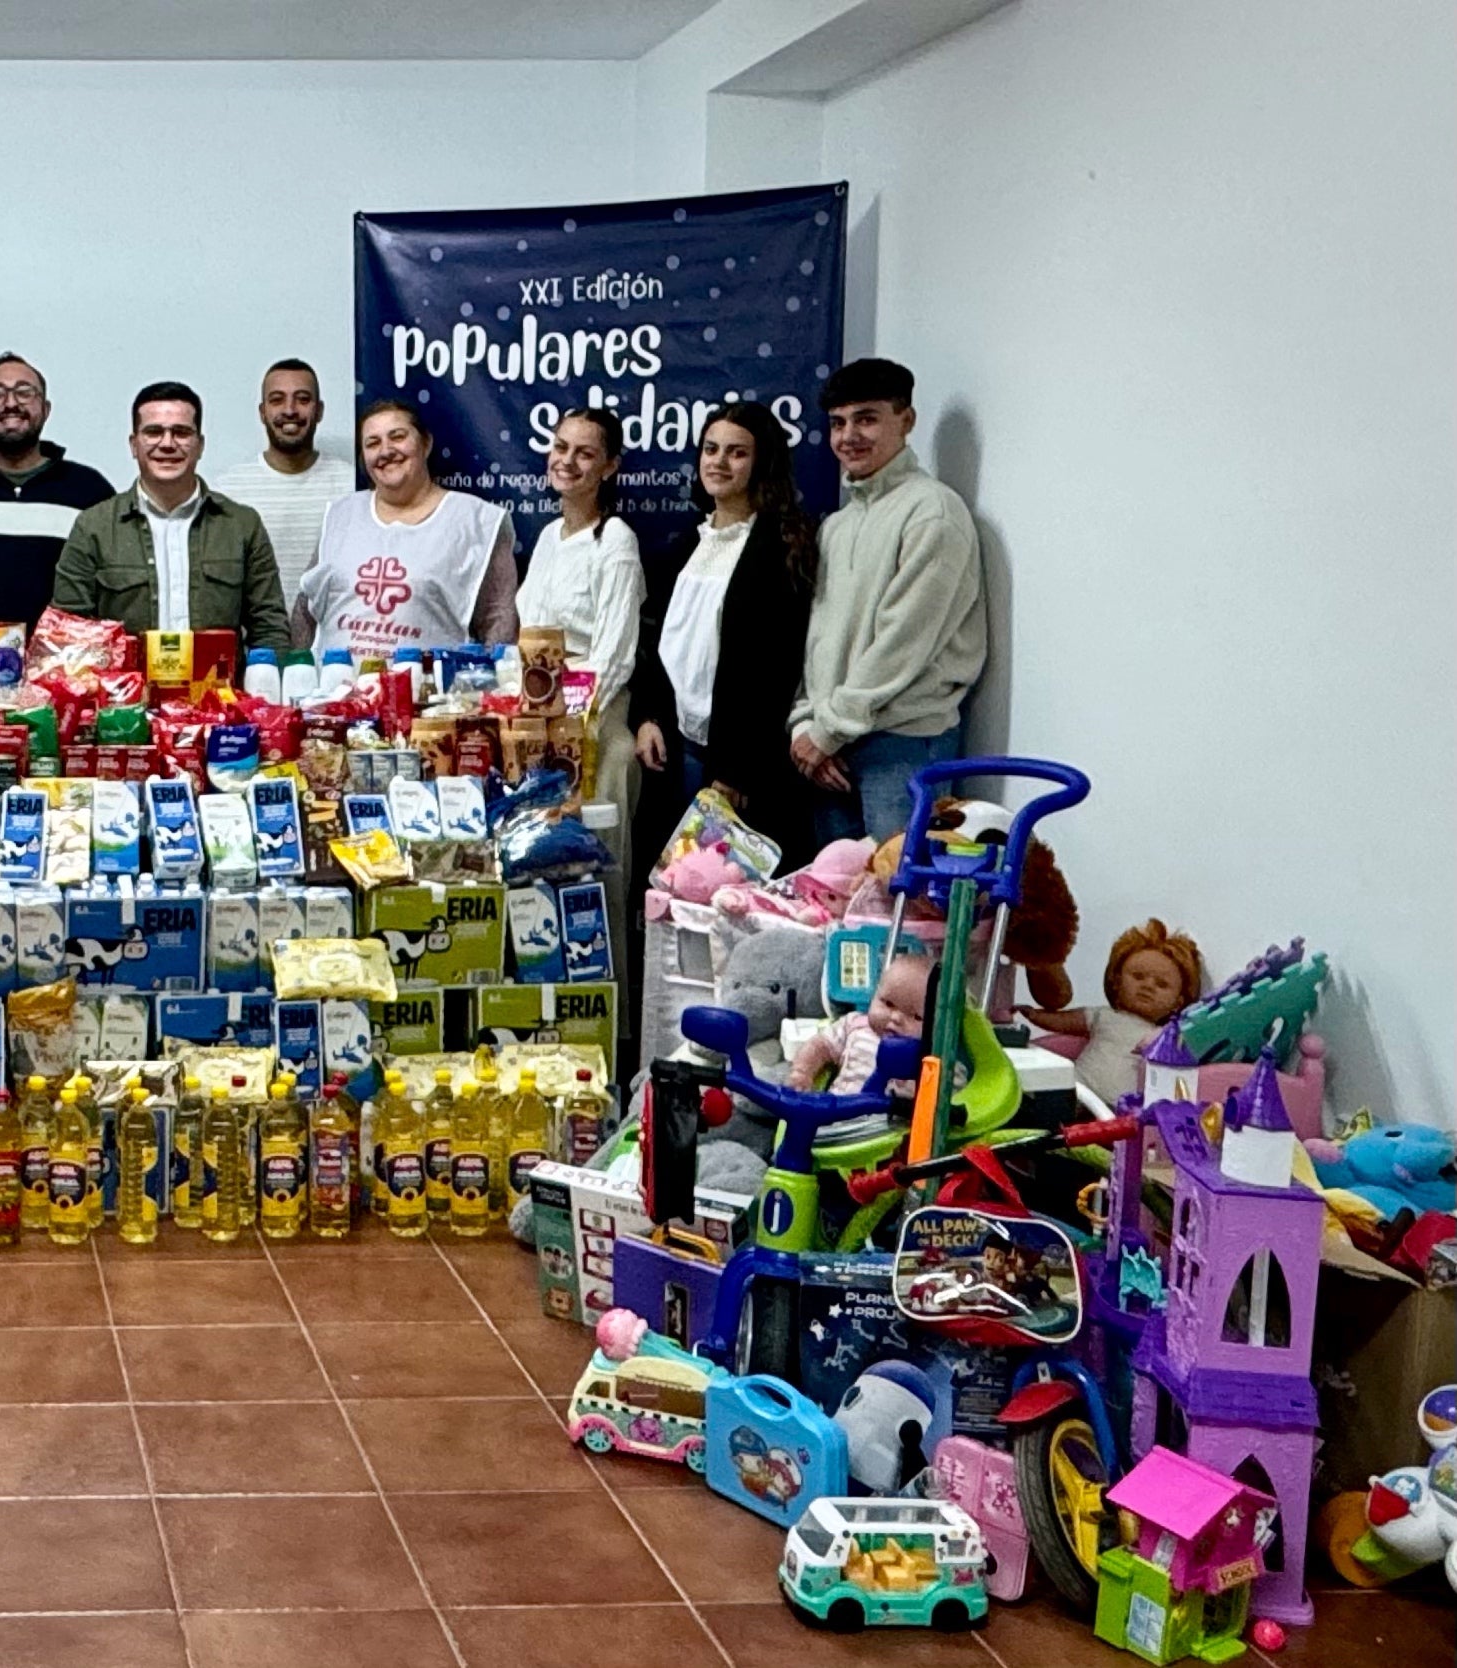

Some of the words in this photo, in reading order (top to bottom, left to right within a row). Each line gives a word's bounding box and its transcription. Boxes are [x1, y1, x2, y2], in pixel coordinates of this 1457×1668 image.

[520, 277, 561, 306] XXI
[572, 272, 663, 301] Edición
[144, 907, 197, 932] ERIA
[447, 896, 498, 921] ERIA
[282, 1007, 318, 1029] ERIA
[384, 1001, 436, 1026] ERIA
[556, 993, 608, 1019] ERIA
[912, 1219, 941, 1234] ALL
[942, 1218, 988, 1232] PAWS
[932, 1233, 980, 1248] DECK!
